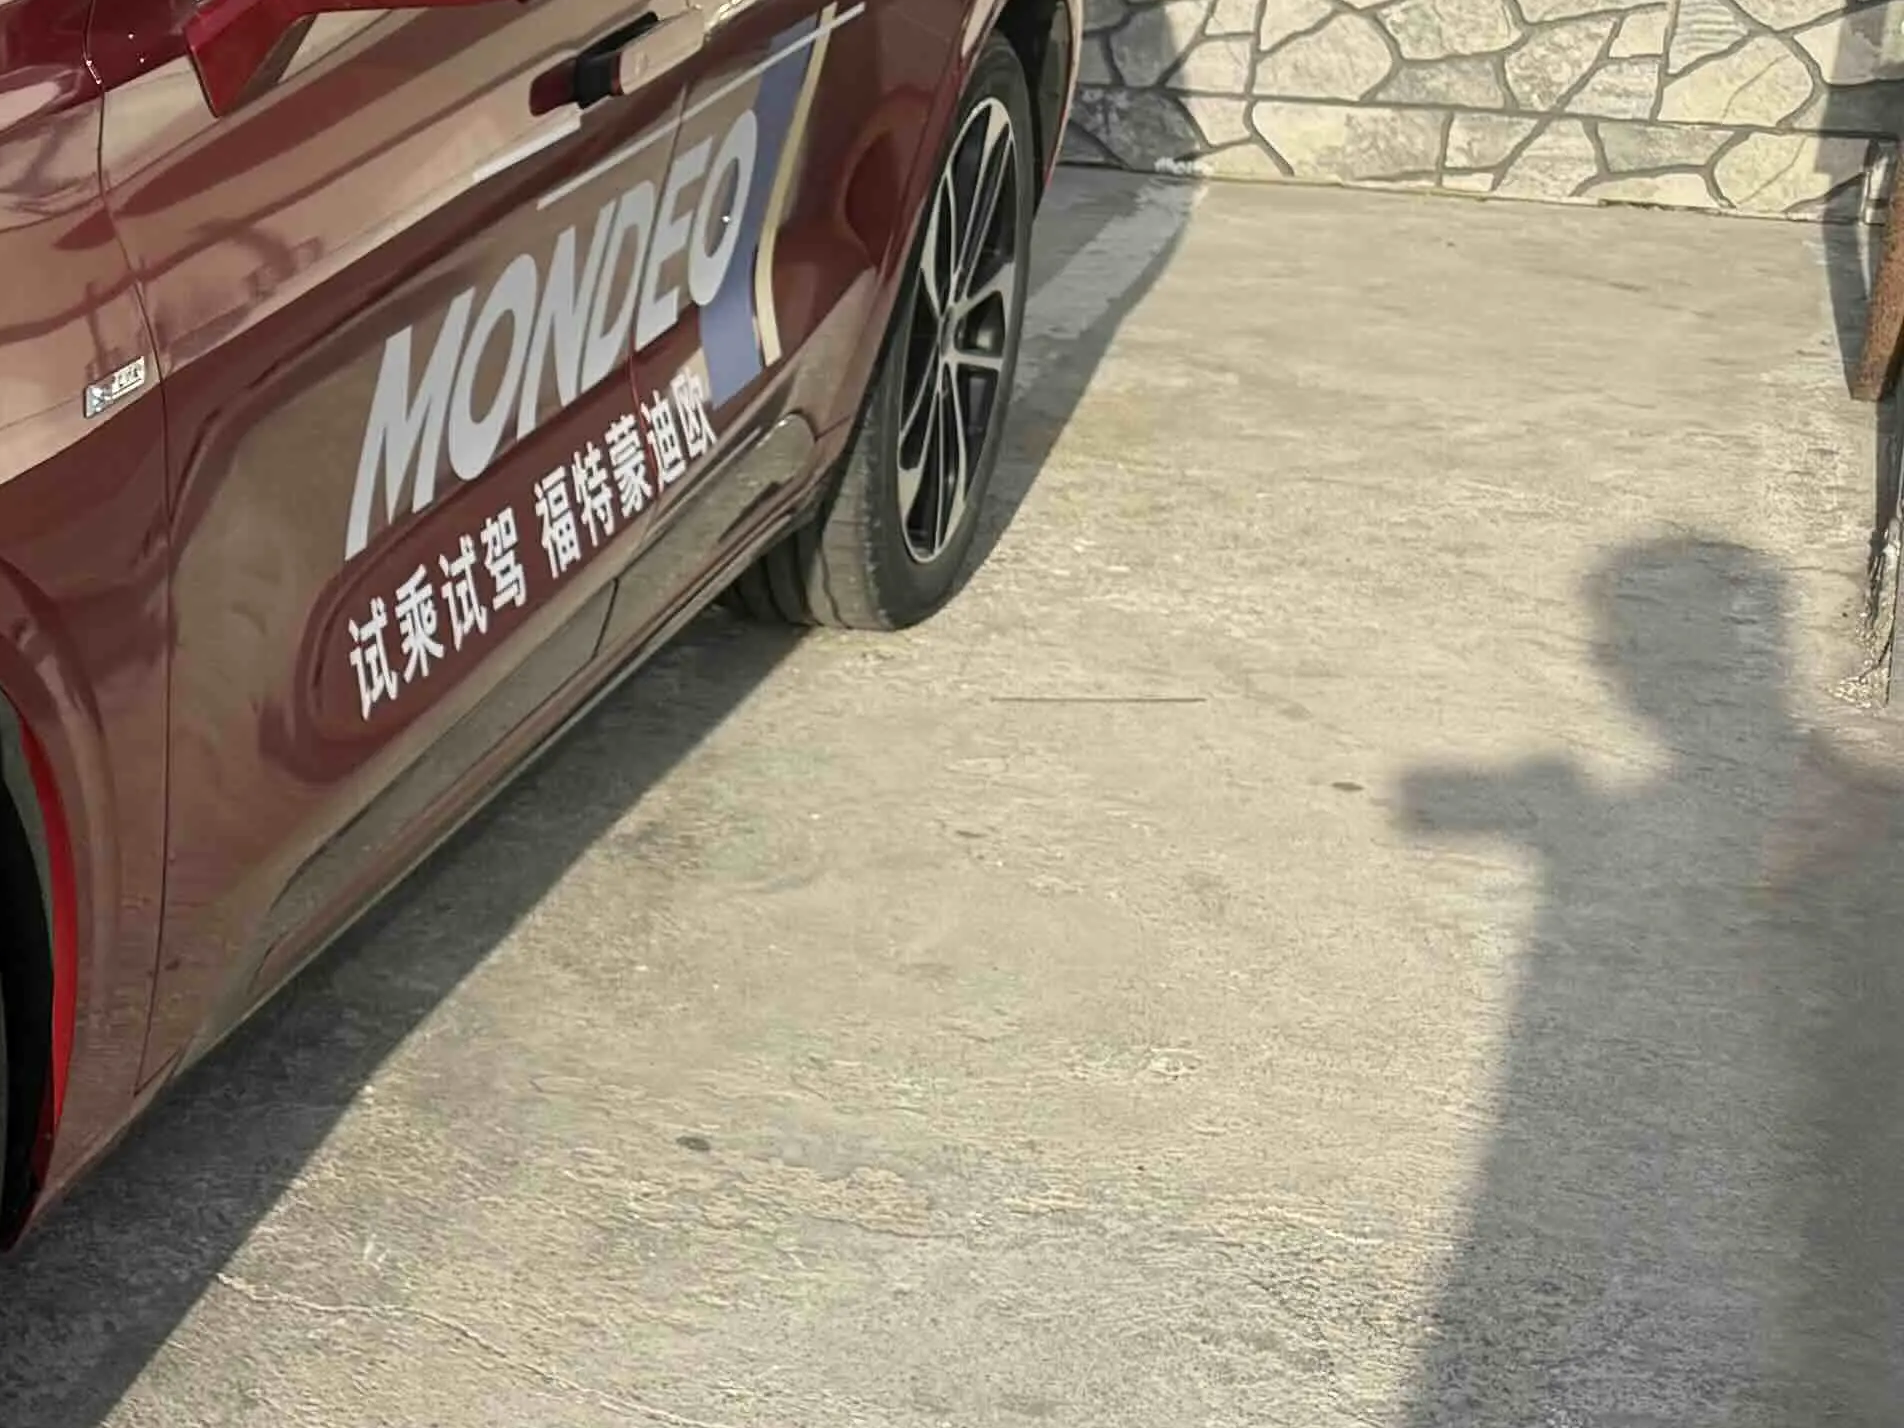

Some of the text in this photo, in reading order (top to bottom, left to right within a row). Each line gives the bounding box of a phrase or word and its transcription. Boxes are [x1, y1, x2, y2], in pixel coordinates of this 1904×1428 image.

[343, 108, 758, 561] MONDEO
[348, 368, 718, 721] 试乘试驾 福特蒙迪欧
